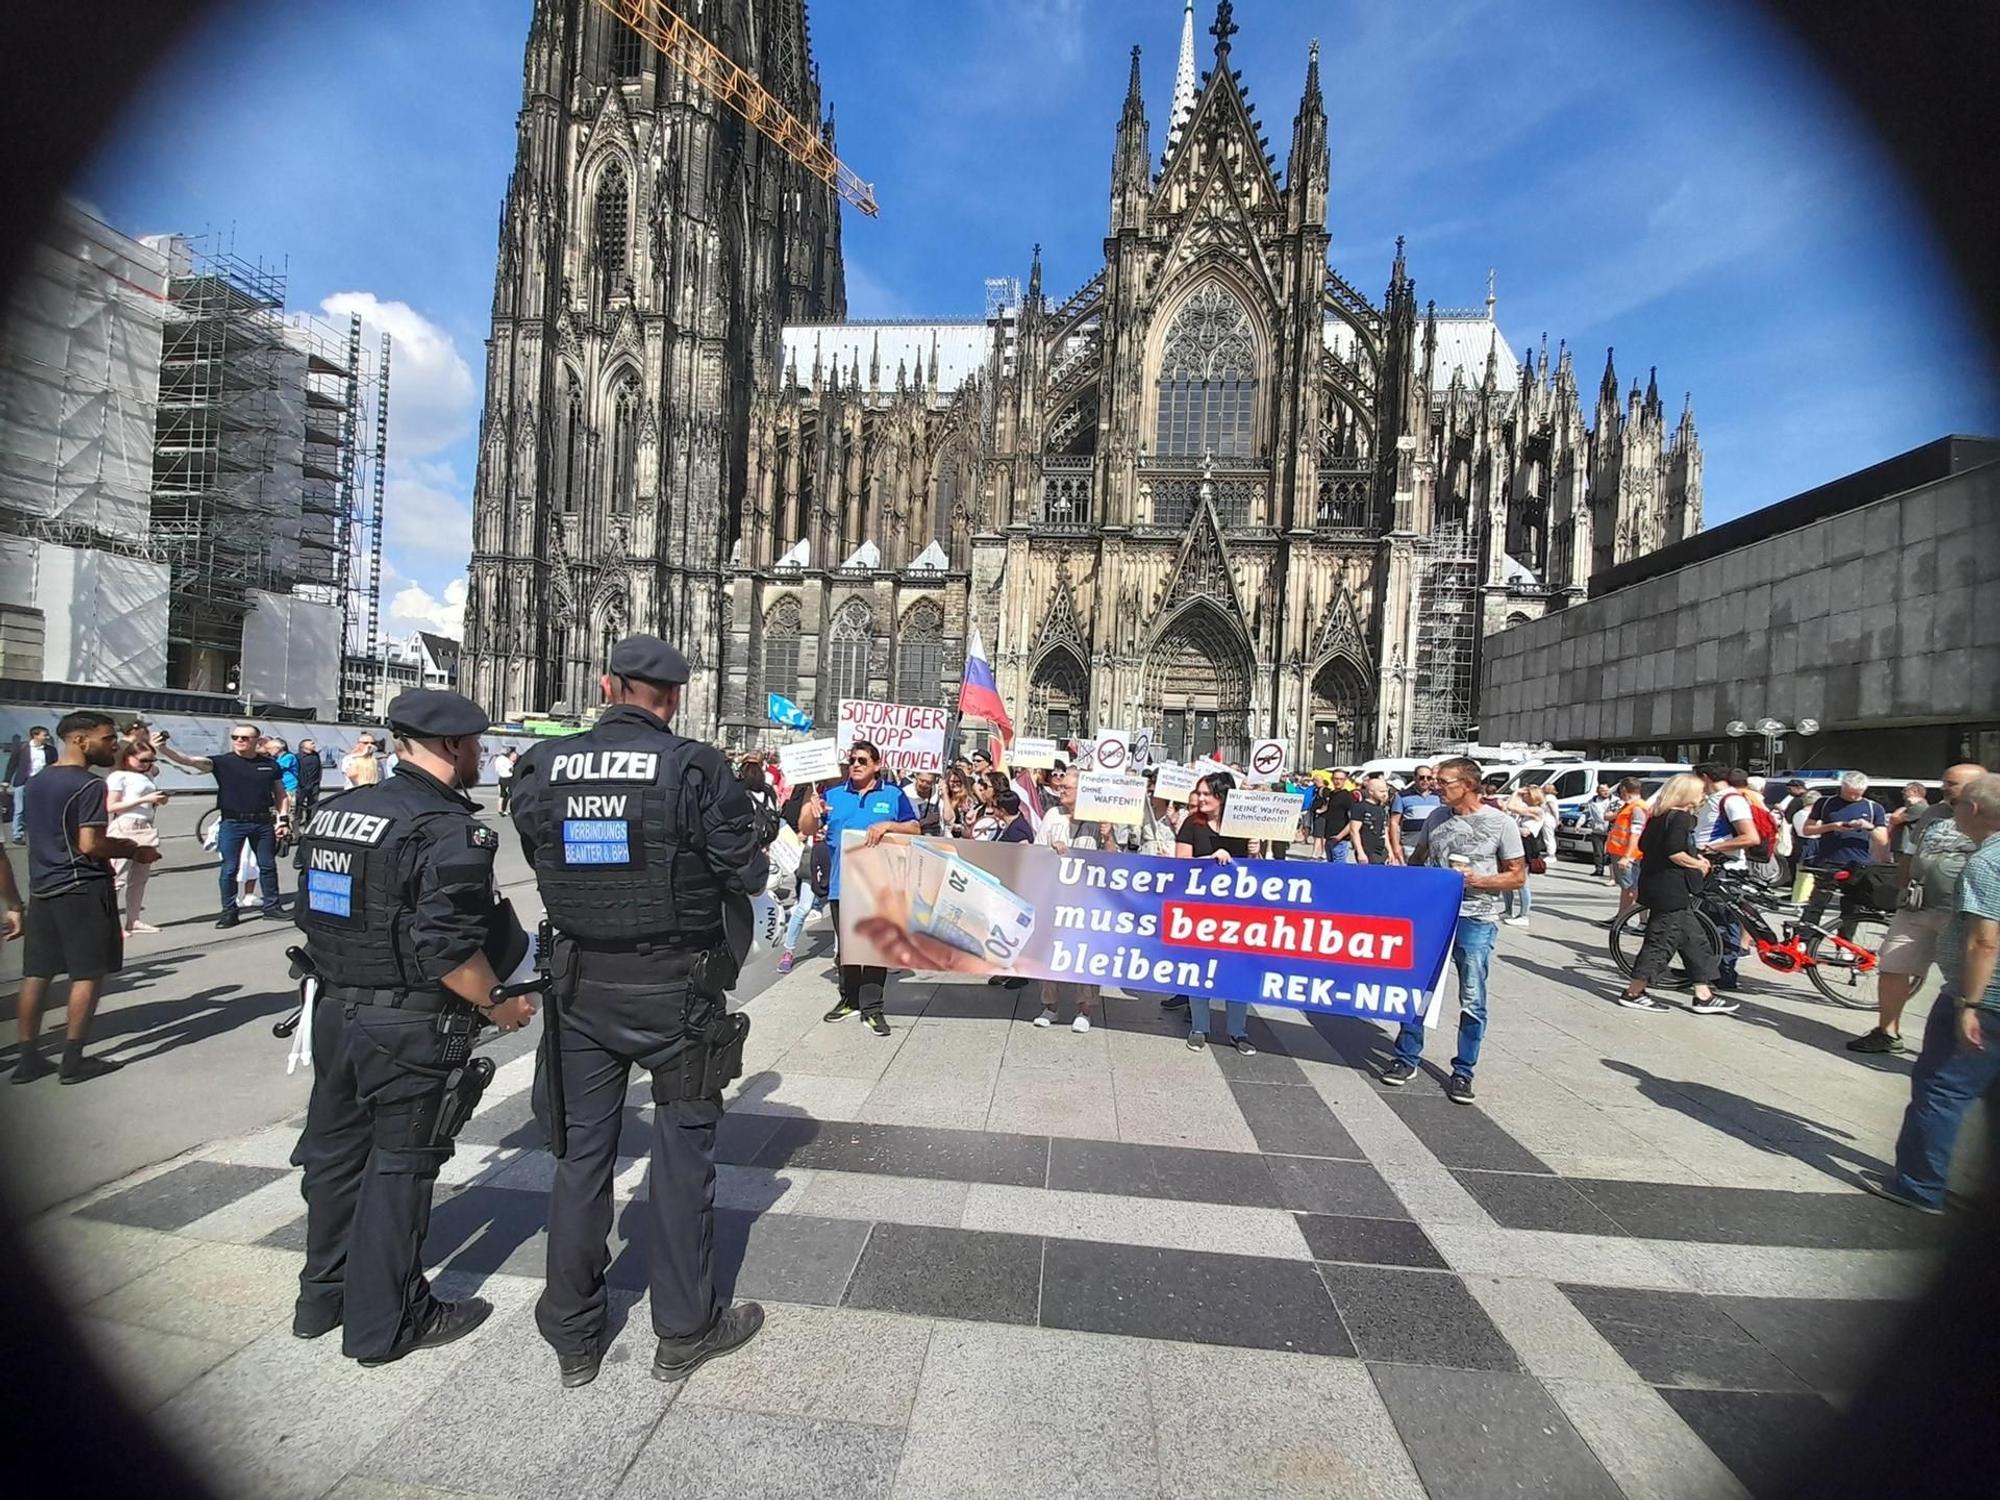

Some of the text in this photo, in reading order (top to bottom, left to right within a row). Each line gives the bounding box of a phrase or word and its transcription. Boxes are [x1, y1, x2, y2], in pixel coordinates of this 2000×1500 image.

[841, 702, 945, 730] SOFORTIGER
[852, 724, 913, 747] STOPP
[550, 751, 658, 781] POLIZEI
[1081, 774, 1111, 782] Frieden
[1081, 786, 1102, 794] OHNE
[1094, 795, 1142, 806] WAFFEN!!!
[1273, 796, 1303, 804] Frieden
[567, 795, 627, 818] NRW
[1260, 806, 1290, 815] Waffen
[304, 810, 389, 843] POLIZEI
[310, 847, 352, 874] NRW
[1058, 857, 1313, 903] Unser Leben
[765, 907, 776, 940] NRW
[1054, 905, 1404, 960] muss bezahlbar
[985, 924, 1019, 959] 20
[1050, 941, 1218, 989] bleiben!
